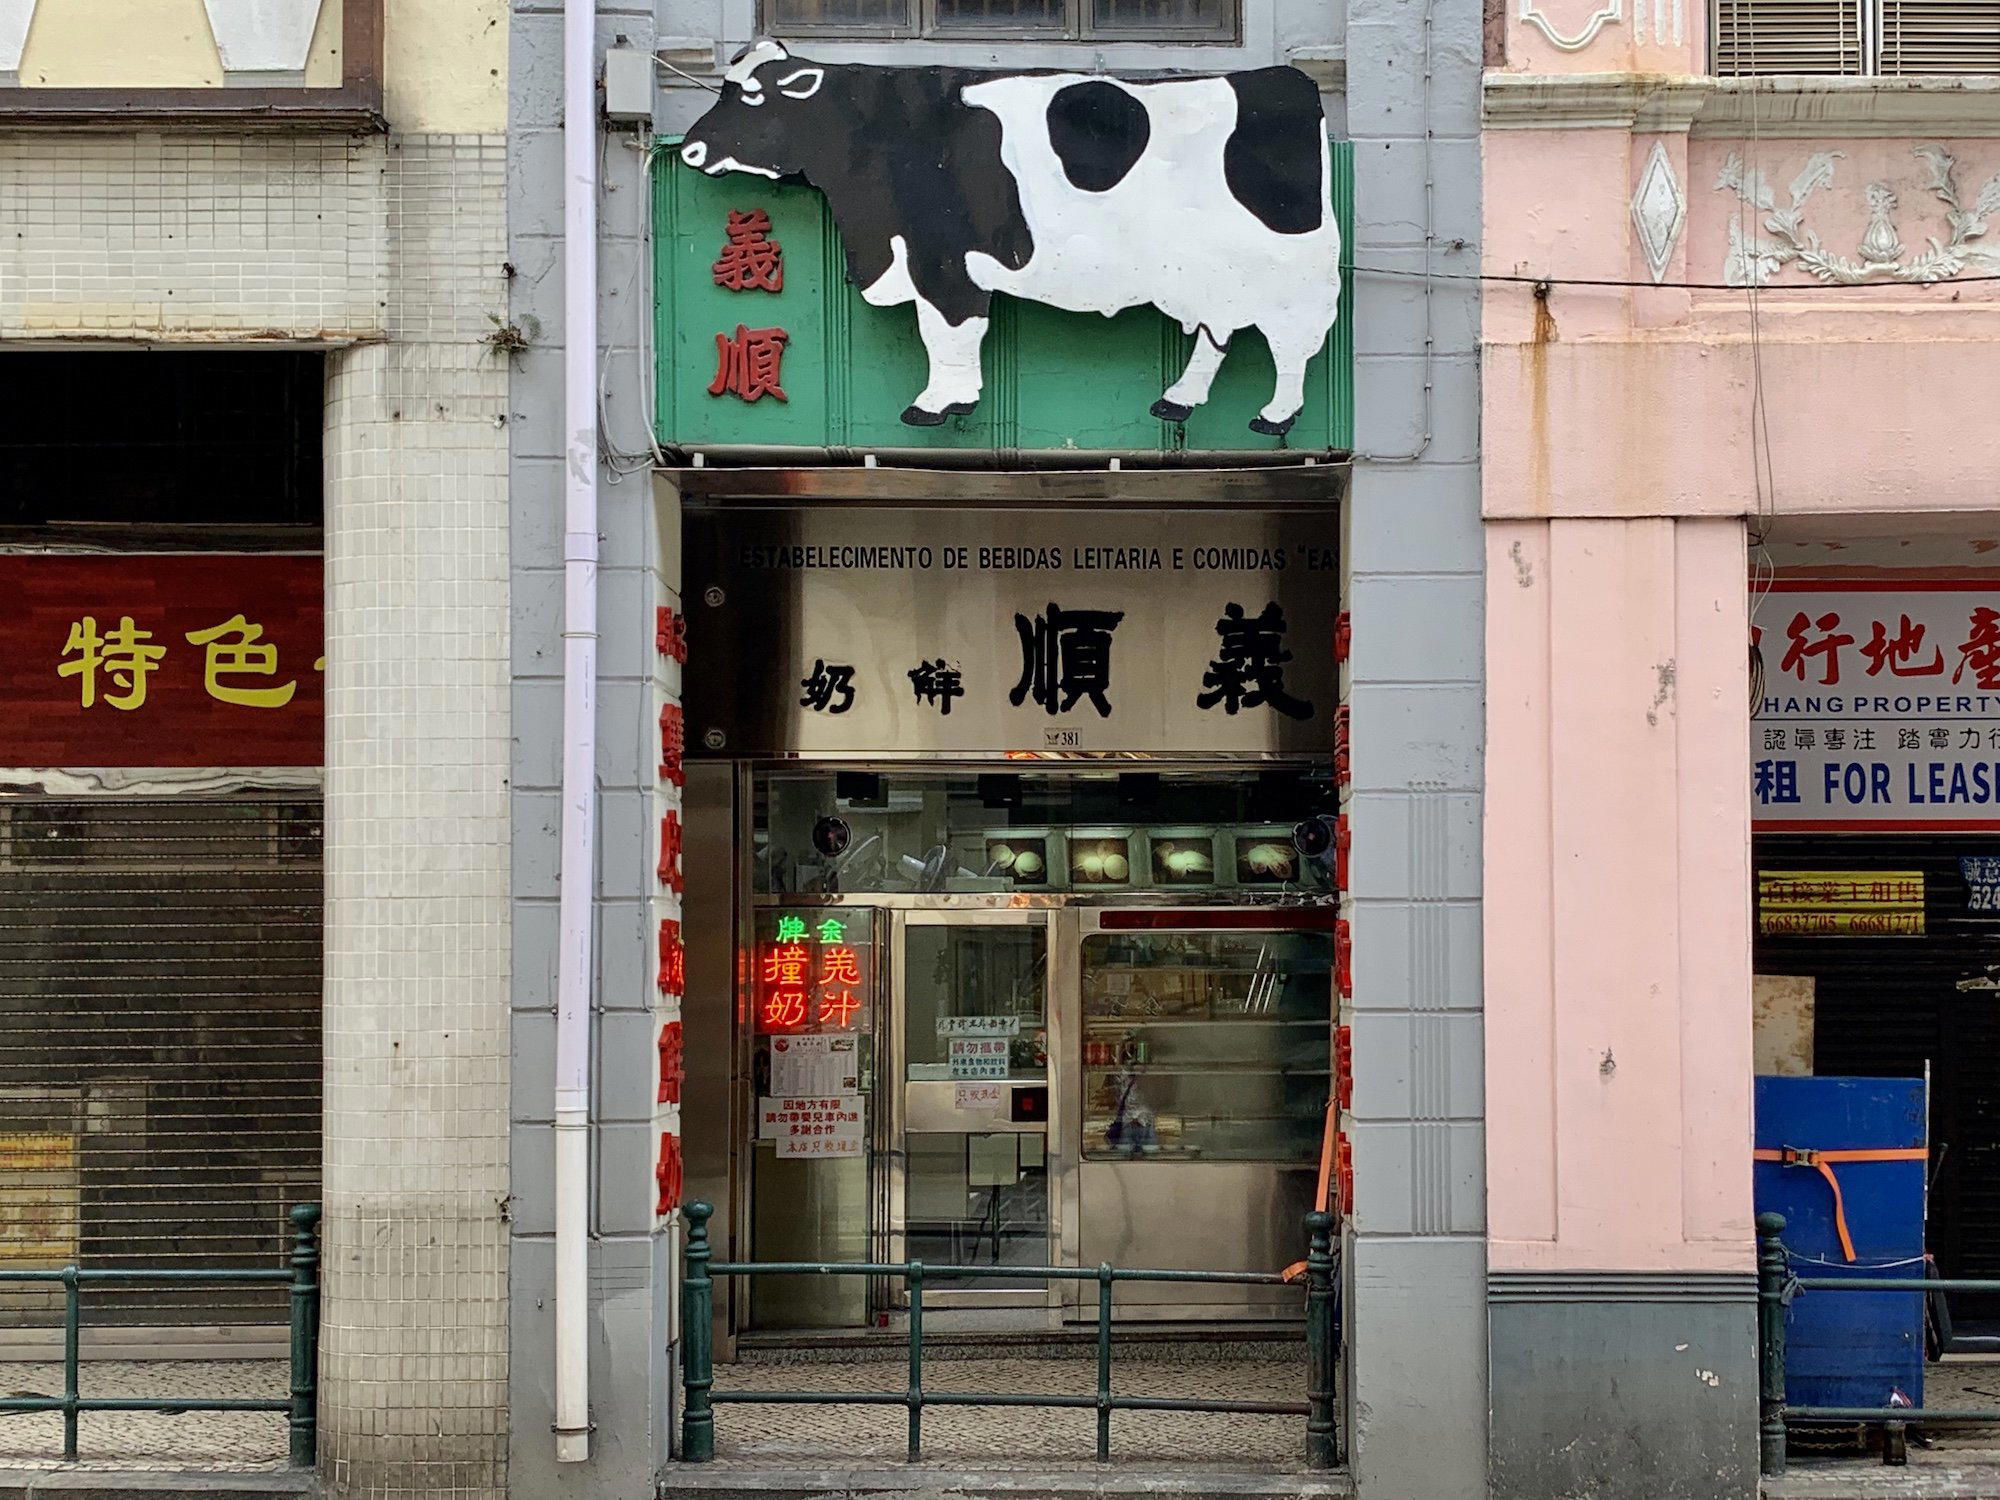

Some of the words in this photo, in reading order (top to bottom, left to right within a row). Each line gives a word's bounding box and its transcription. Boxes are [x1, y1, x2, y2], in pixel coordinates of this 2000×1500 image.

[707, 208, 789, 403] 義順
[739, 547, 932, 569] ESTABELECIMENTO
[943, 547, 968, 569] DE
[979, 547, 1062, 569] BEBIDAS
[1073, 547, 1162, 569] LEITARIA
[1173, 547, 1184, 569] E
[1193, 547, 1286, 570] COMIDAS
[1297, 545, 1340, 570] “EA
[57, 614, 325, 710] 特色
[1764, 696, 1843, 713] HANG
[1060, 731, 1080, 746] 381
[1754, 759, 1801, 805] 租
[1824, 762, 1891, 805] FOR
